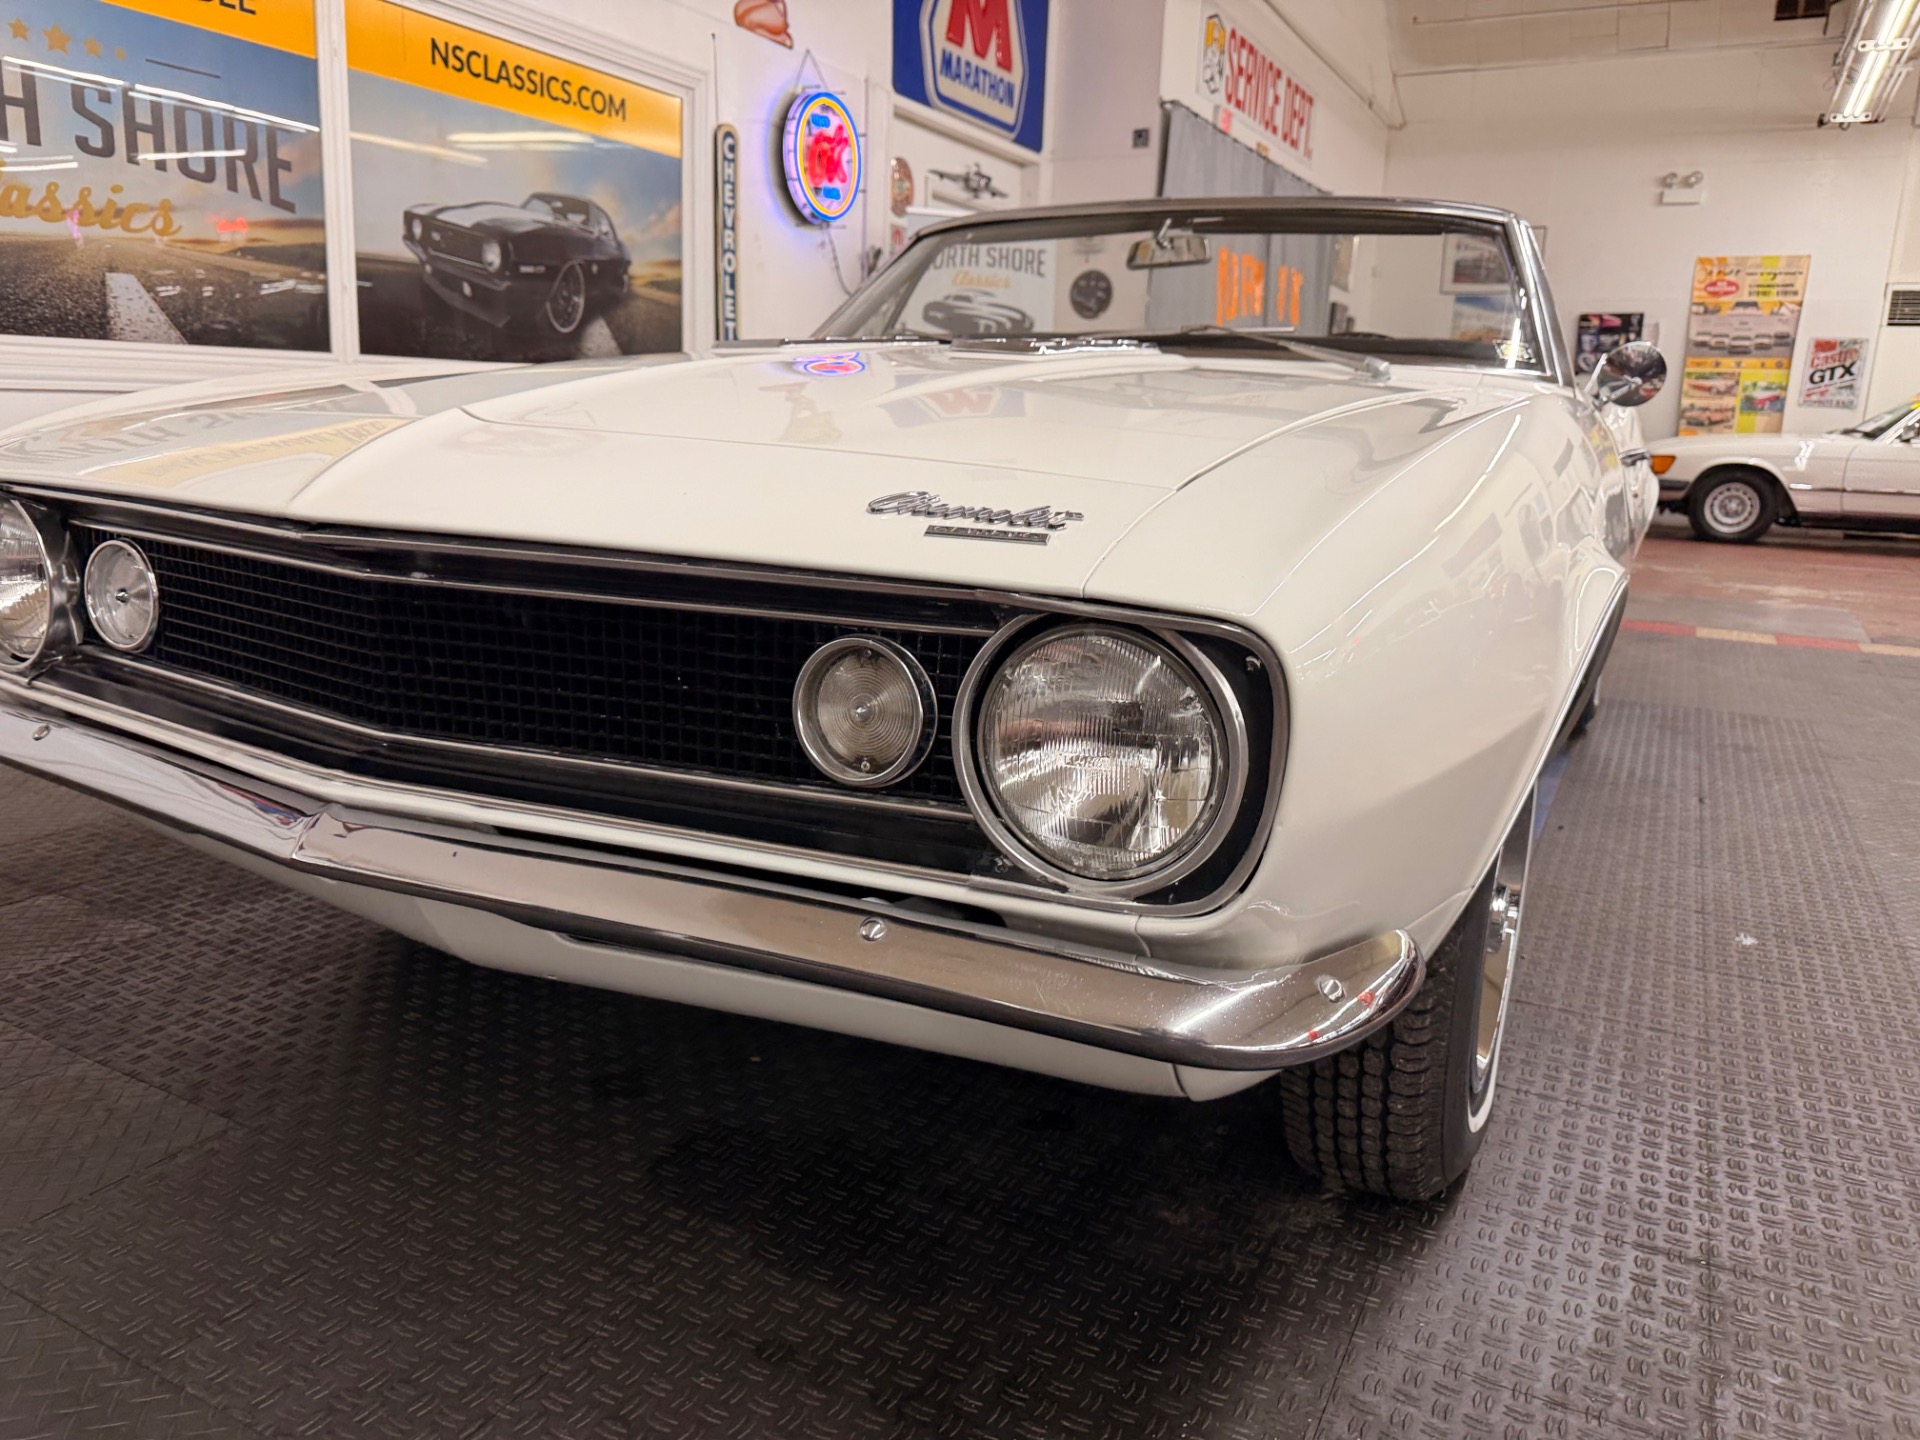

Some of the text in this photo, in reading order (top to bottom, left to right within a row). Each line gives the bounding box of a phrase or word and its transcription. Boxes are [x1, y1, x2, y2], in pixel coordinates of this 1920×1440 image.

[430, 37, 626, 122] NSCLASSICS.COM
[940, 48, 1015, 109] MARATHON
[1225, 27, 1282, 136] SERVICE
[71, 76, 296, 214] SHORE
[722, 132, 739, 341] CHEVROLET
[933, 244, 1046, 278] ORTH SHORE
[1809, 361, 1857, 385] GTX
